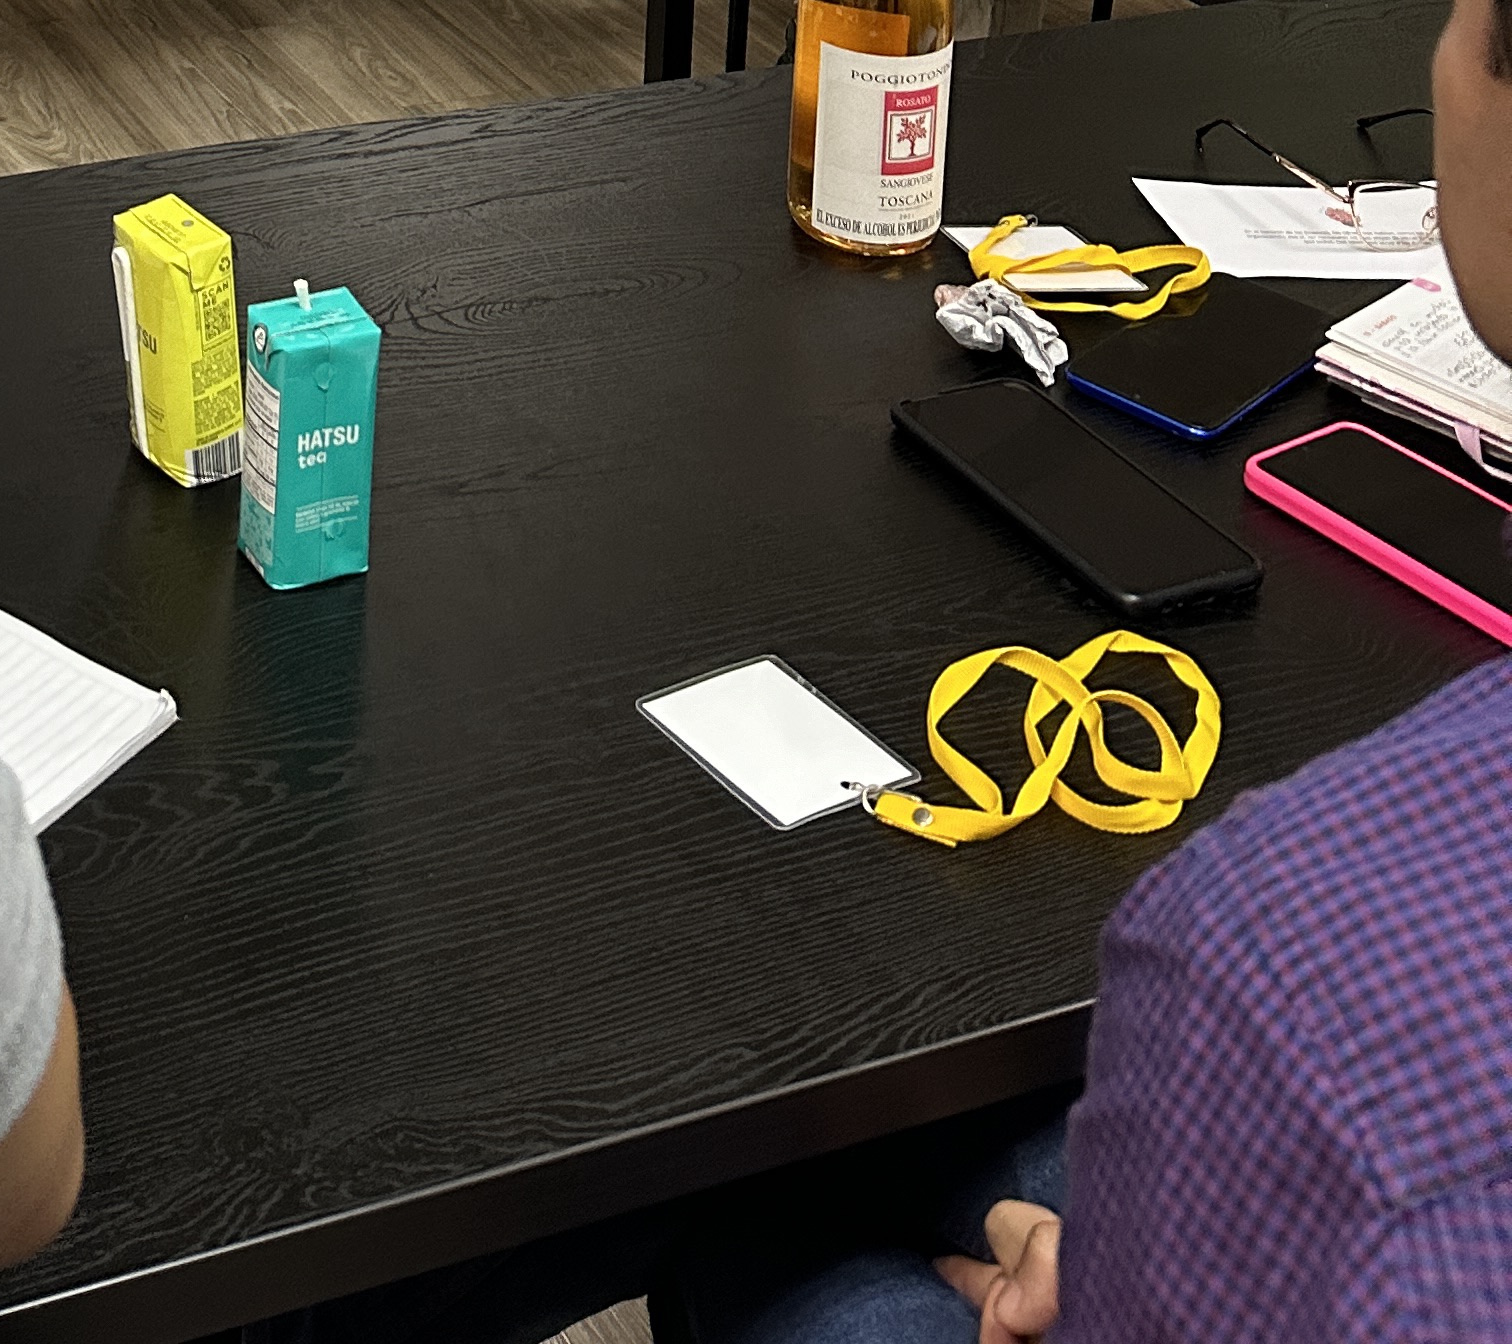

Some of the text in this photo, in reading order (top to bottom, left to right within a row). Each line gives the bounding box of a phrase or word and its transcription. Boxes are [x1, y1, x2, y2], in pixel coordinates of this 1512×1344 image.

[896, 94, 931, 108] ROSATO
[878, 190, 933, 207] TOSCANA
[816, 208, 824, 224] EL
[825, 212, 851, 231] EXCESO
[852, 220, 862, 233] DE
[864, 222, 897, 236] ALCOHOL
[202, 280, 229, 299] SCAN
[297, 424, 360, 453] HATSU
[298, 451, 327, 469] tea
